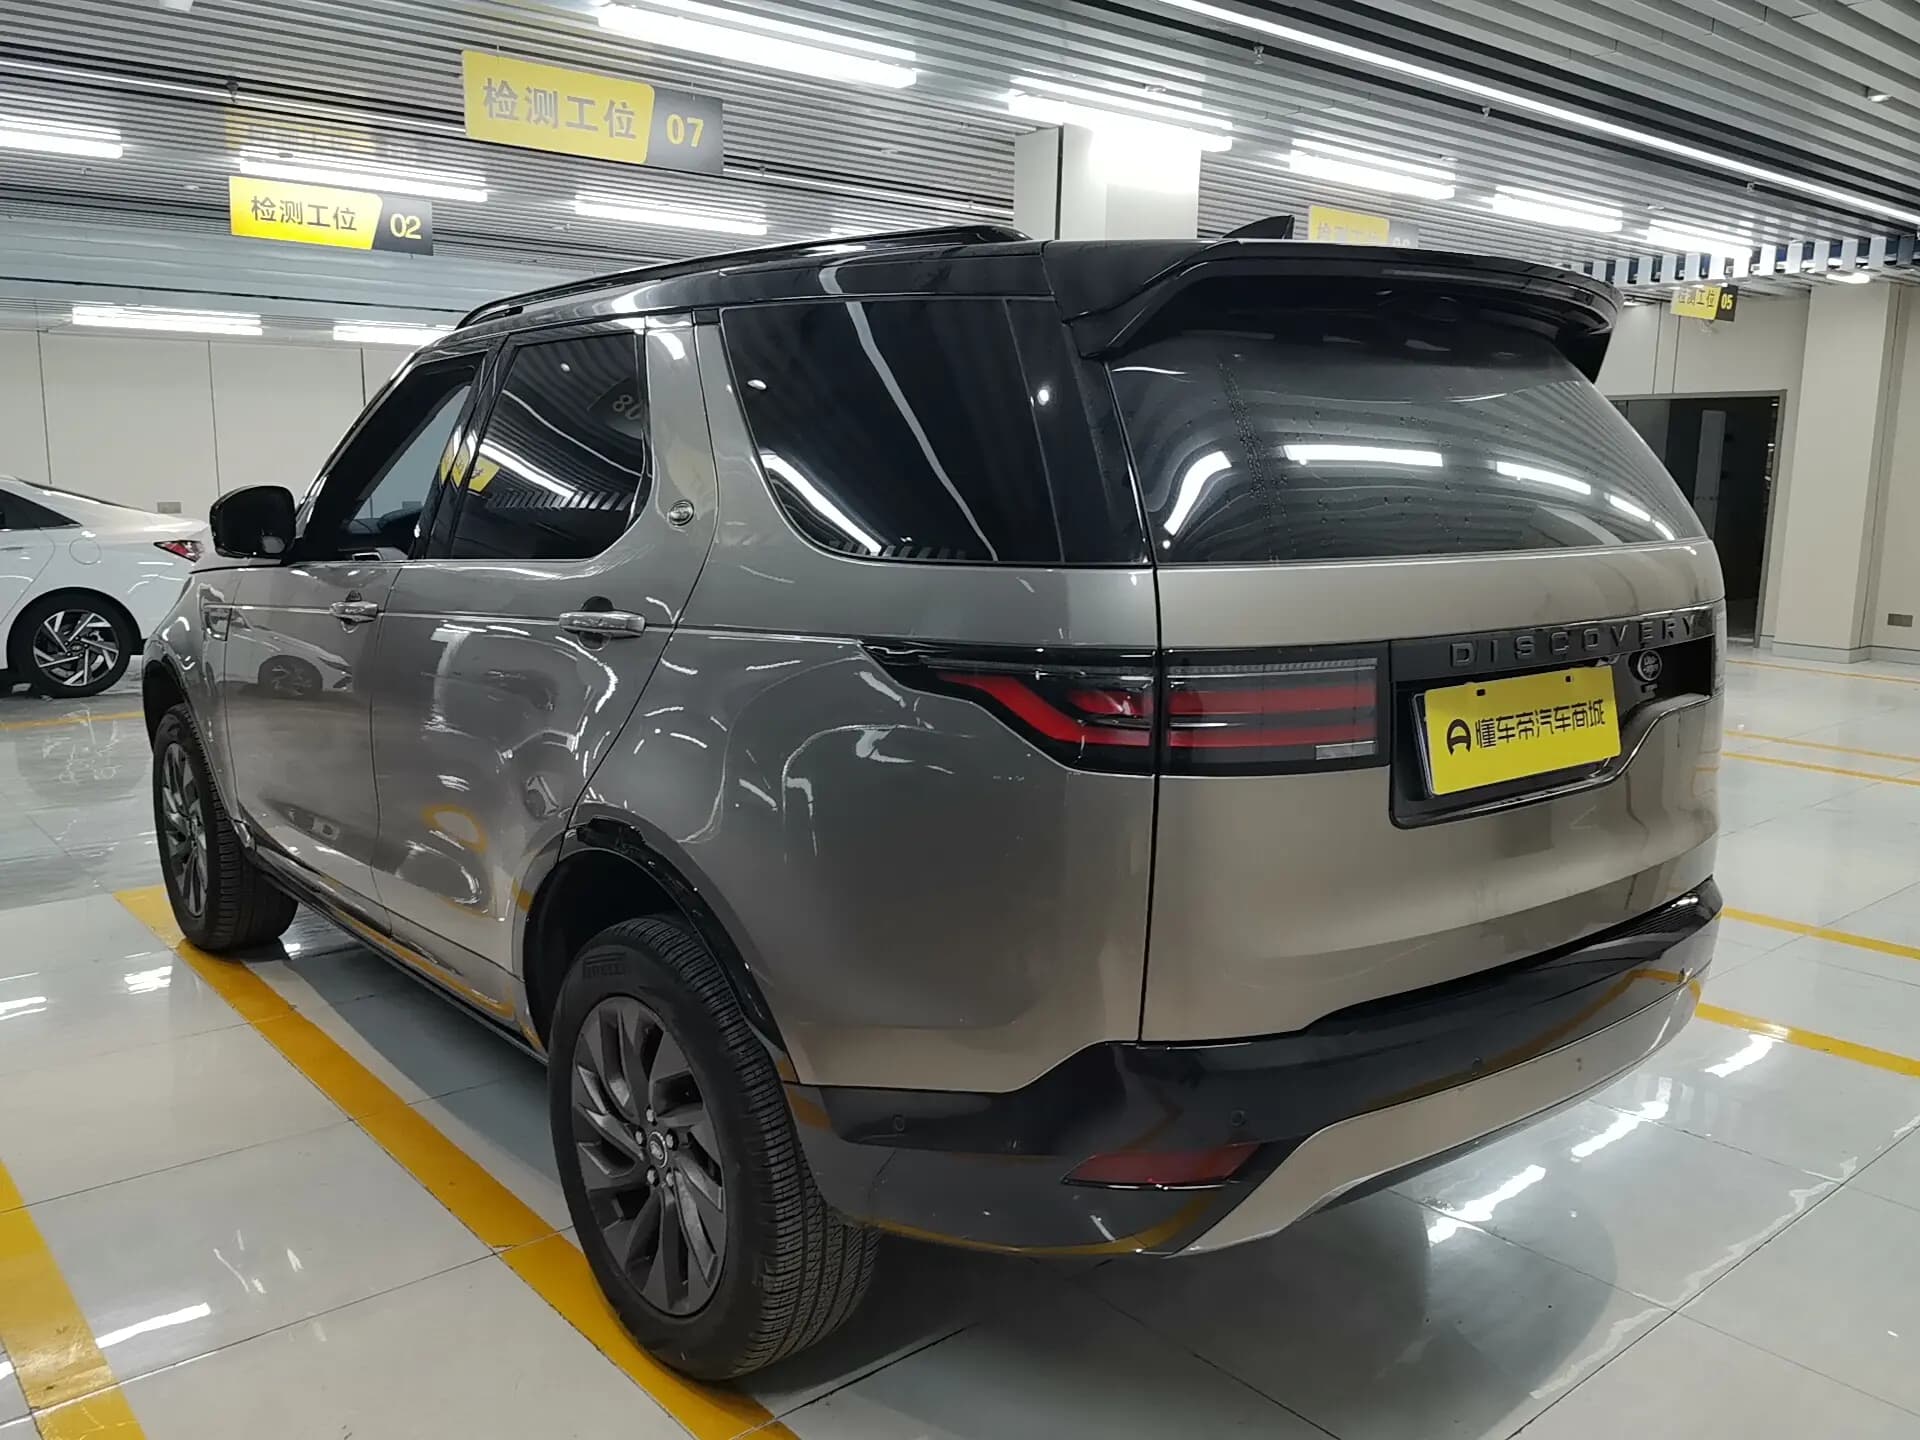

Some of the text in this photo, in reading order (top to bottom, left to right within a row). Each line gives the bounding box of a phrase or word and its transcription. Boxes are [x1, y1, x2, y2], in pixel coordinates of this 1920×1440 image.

[483, 78, 705, 148] 检测工位 07
[251, 195, 422, 239] 检测工位 02
[1721, 293, 1734, 310] 05
[1451, 615, 1695, 666] DISCOVERY
[1475, 699, 1605, 748] 懂车帝汽车商城
